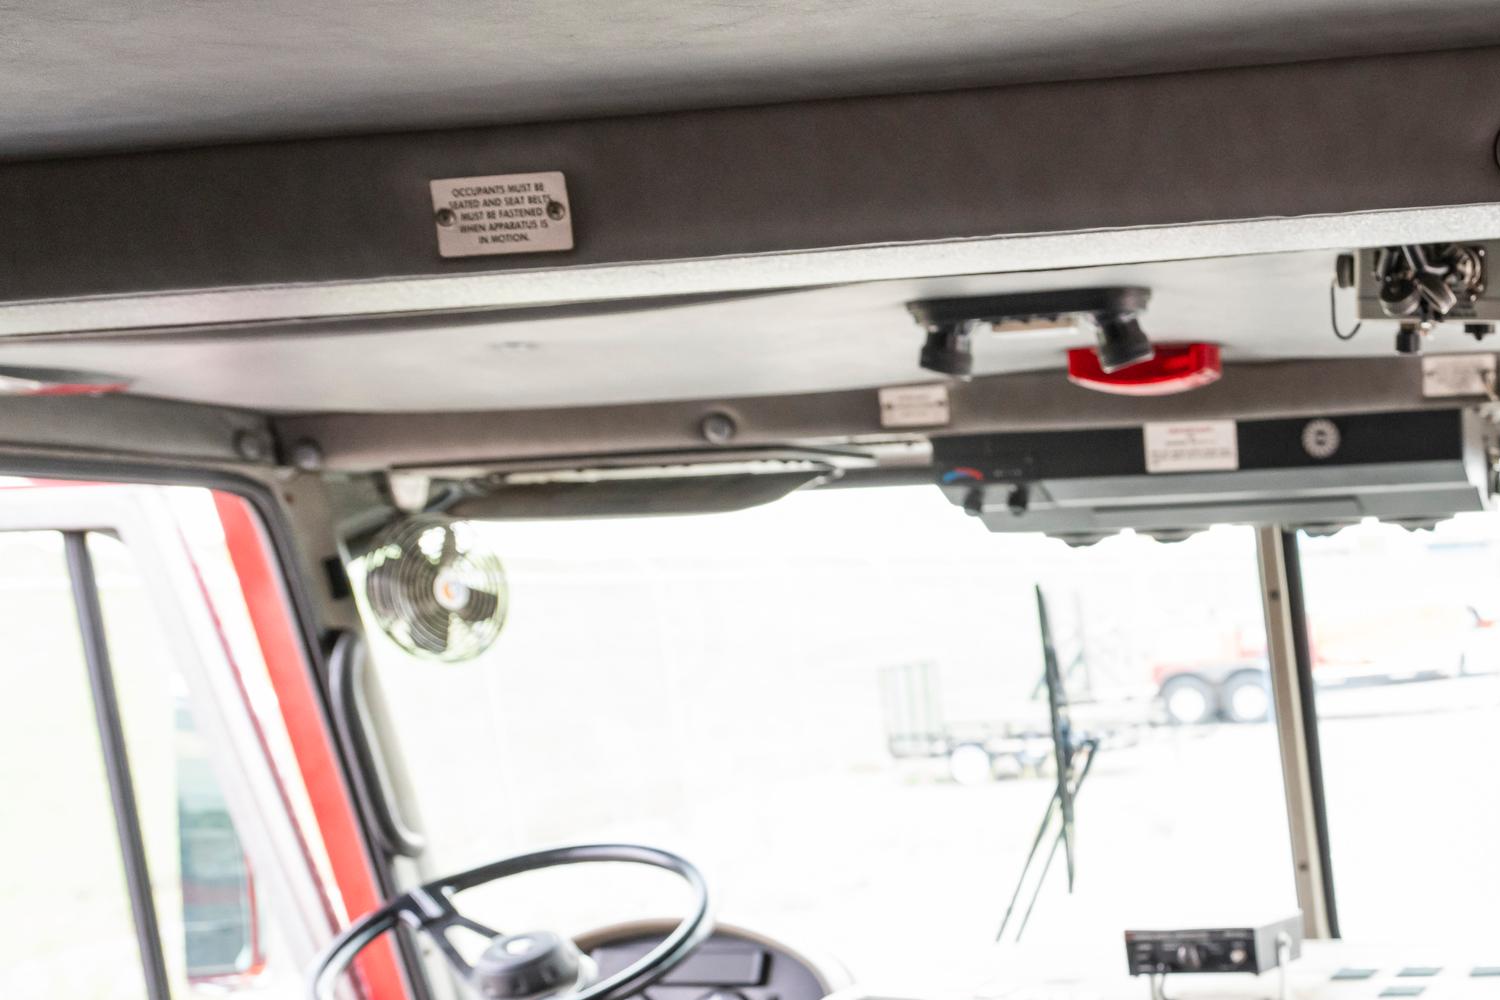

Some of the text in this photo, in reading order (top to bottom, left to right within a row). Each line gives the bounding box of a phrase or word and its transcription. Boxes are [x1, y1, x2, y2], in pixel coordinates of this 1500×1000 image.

[452, 182, 544, 198] OCCUPANTS MUST BE
[482, 198, 502, 207] AND
[504, 196, 524, 206] SEAT
[460, 207, 543, 221] MUST BE FASTENED
[460, 219, 548, 233] WHEN APPARATUS IS
[479, 236, 489, 244] IN
